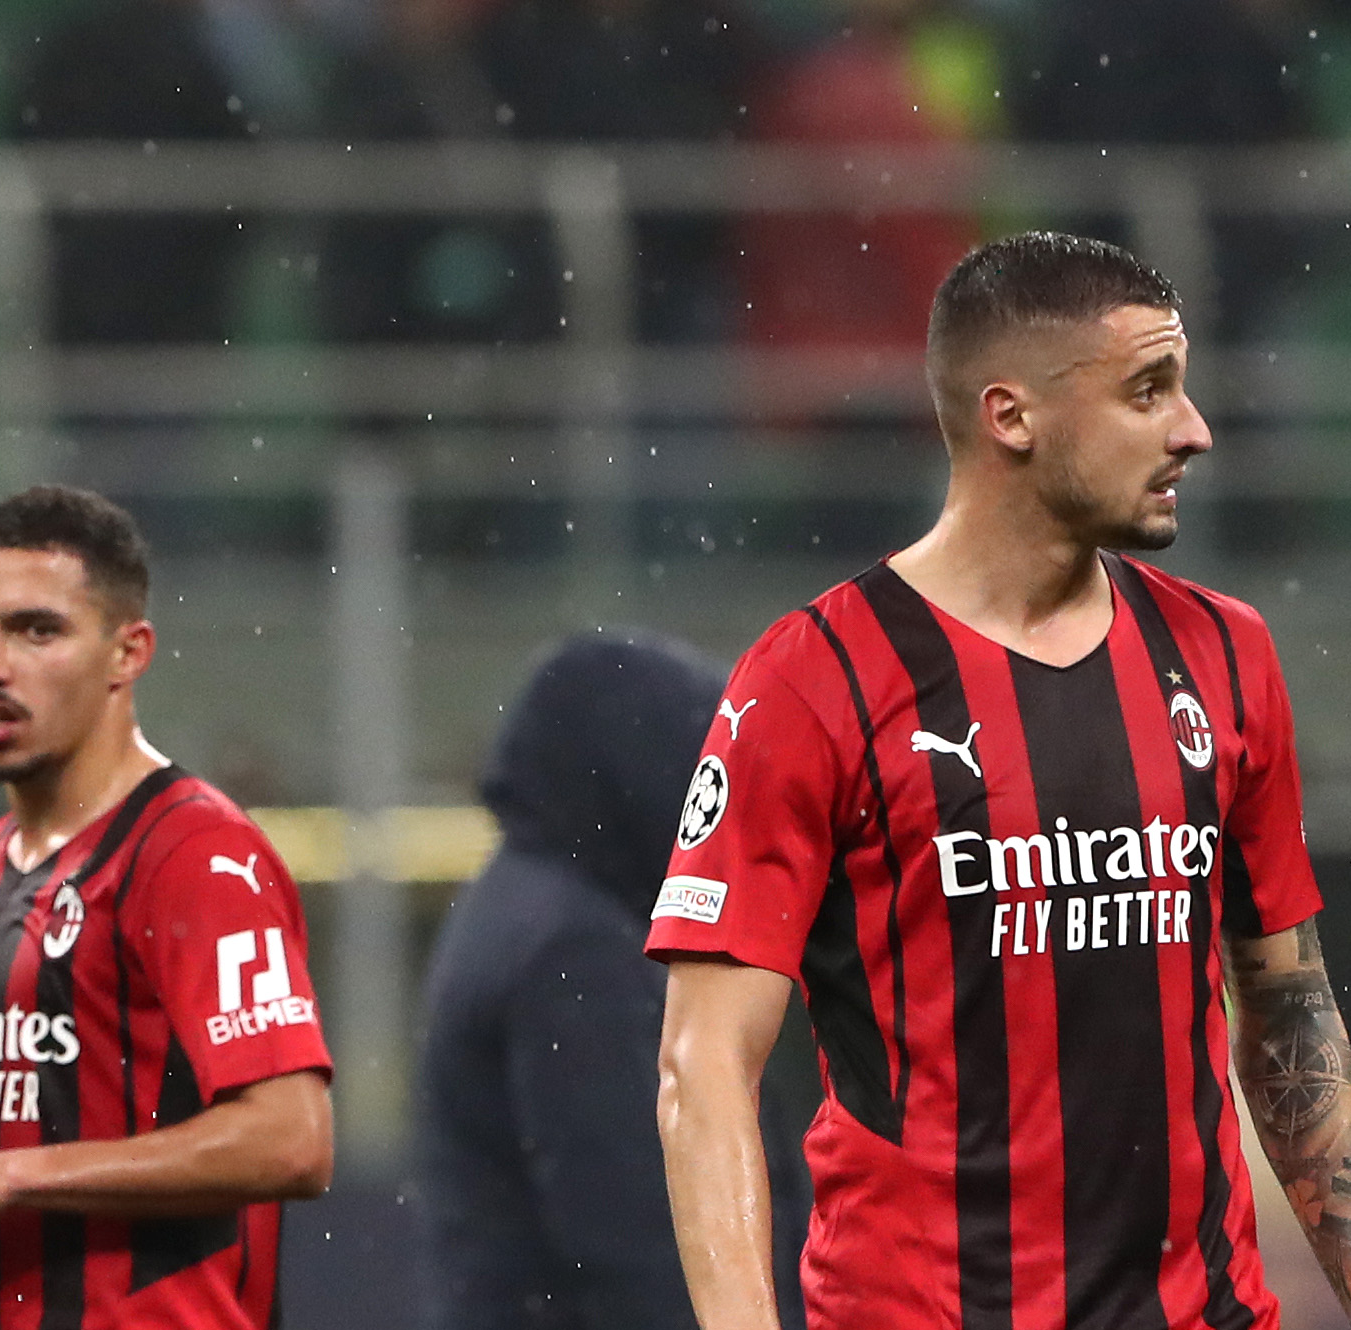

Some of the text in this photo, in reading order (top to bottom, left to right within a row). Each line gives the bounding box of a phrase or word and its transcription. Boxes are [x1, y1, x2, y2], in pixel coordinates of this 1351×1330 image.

[932, 815, 1218, 897] Emirates
[991, 890, 1192, 957] FLY BETTER
